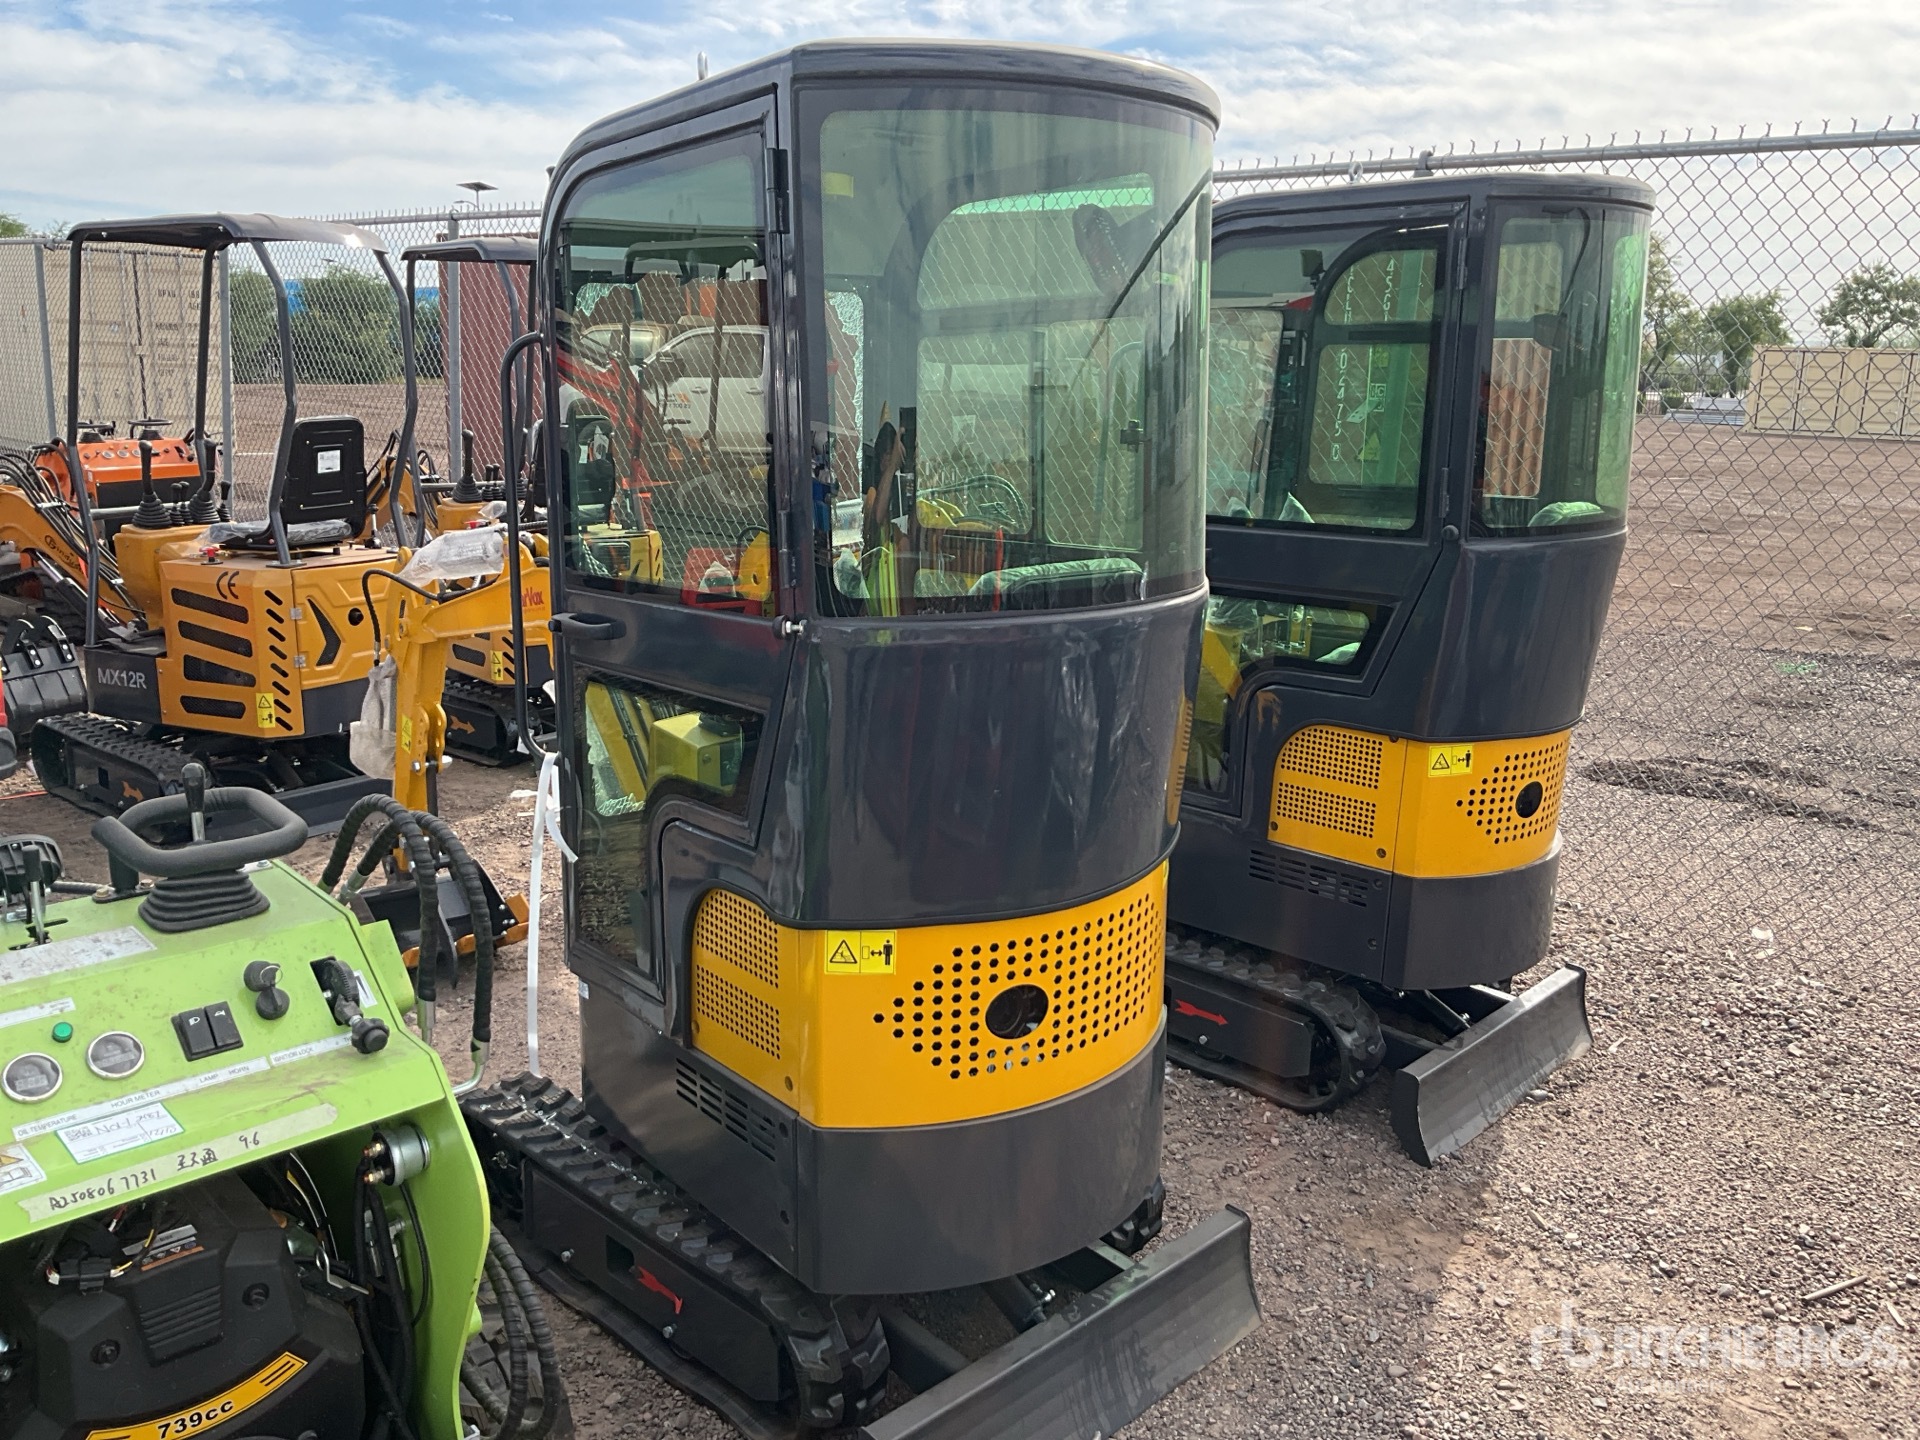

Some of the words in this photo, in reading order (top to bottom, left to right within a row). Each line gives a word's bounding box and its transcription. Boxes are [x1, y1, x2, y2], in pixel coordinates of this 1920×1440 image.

[97, 667, 147, 689] MX12R
[200, 1073, 219, 1083] LAMP
[228, 1065, 250, 1075] HORN
[111, 1096, 134, 1109] HOUR
[135, 1089, 161, 1102] METER
[30, 1113, 78, 1133] TEMPERATURE
[157, 1400, 234, 1440] 739cc
